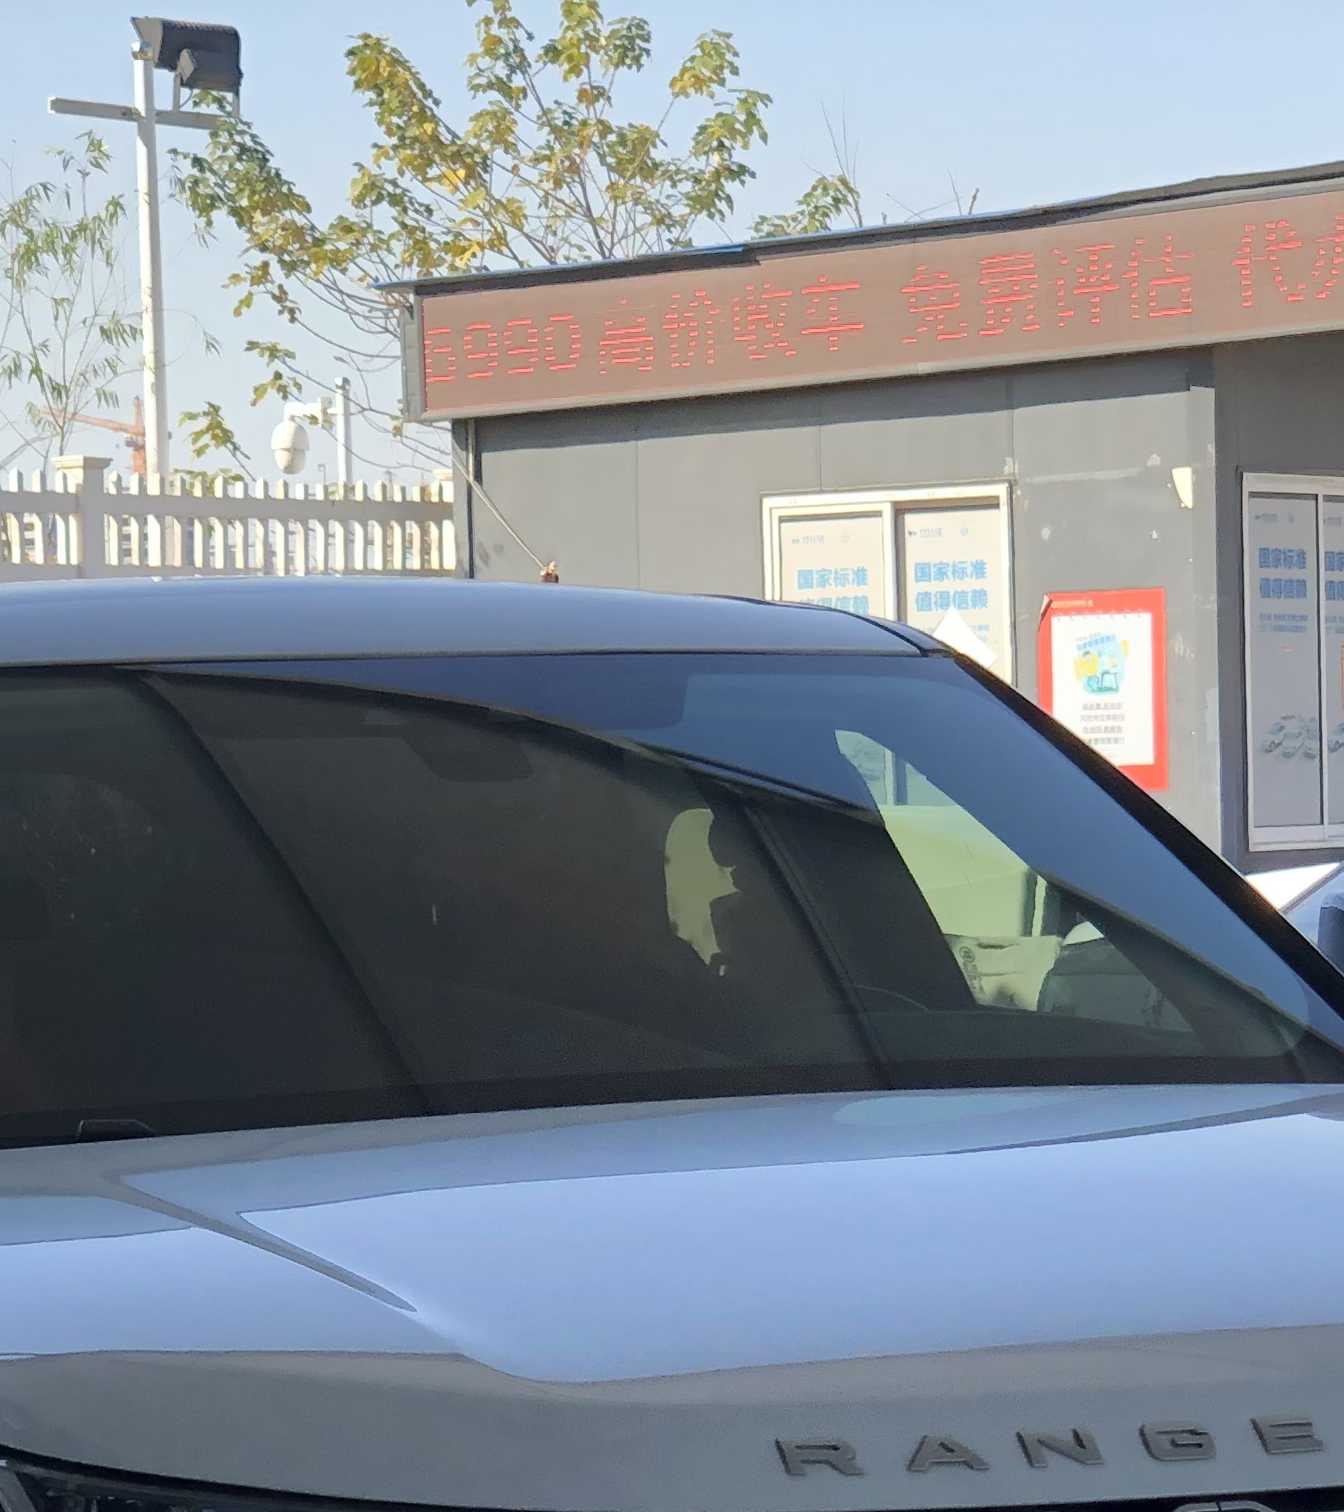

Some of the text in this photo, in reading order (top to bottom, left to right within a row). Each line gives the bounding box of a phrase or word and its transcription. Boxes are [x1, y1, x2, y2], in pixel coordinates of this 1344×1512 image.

[900, 233, 1194, 344] 免费评估
[798, 566, 869, 589] 国家标准
[914, 559, 987, 582] 国家标准
[774, 1415, 1324, 1477] RANGE
